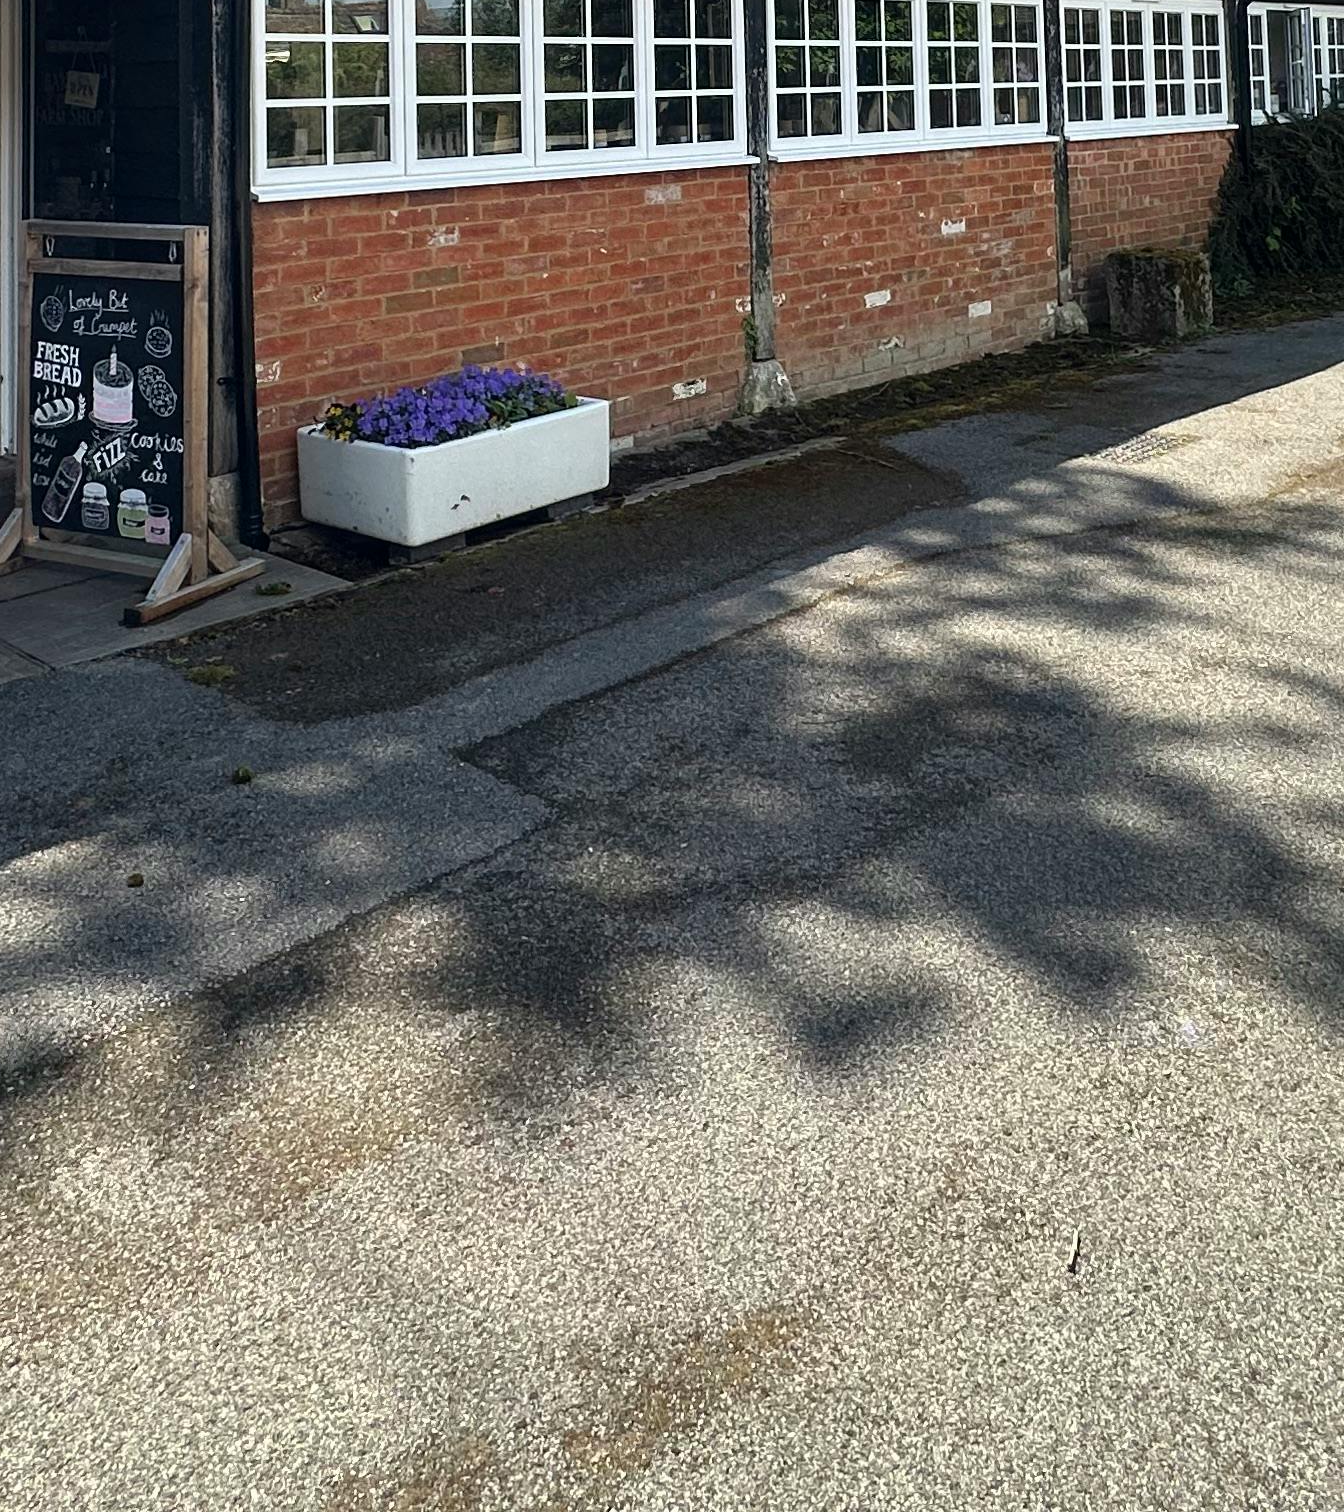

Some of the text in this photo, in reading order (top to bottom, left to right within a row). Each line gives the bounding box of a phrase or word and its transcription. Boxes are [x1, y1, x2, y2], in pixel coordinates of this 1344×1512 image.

[69, 289, 129, 316] Lovely Bit
[73, 316, 138, 340] of Crumpet
[36, 341, 80, 367] FRESH
[33, 361, 82, 387] BREAD
[152, 453, 164, 470] &
